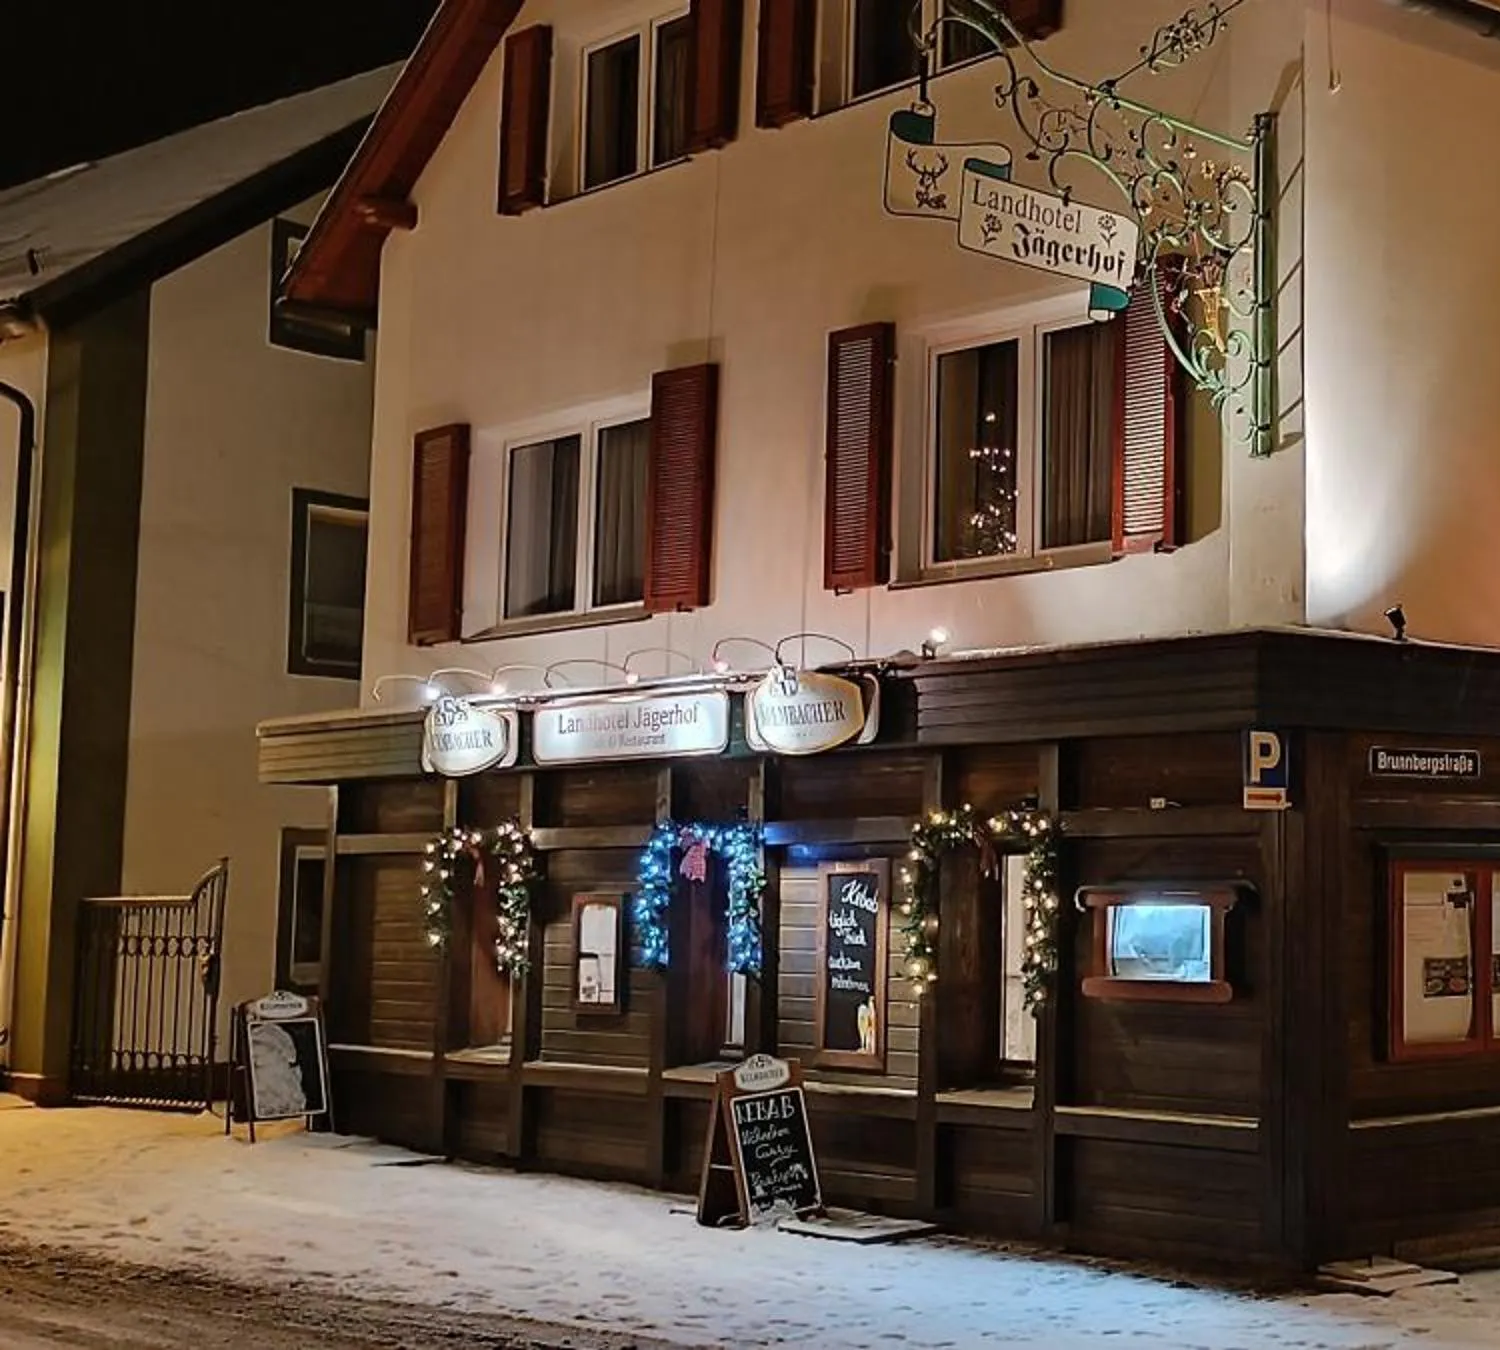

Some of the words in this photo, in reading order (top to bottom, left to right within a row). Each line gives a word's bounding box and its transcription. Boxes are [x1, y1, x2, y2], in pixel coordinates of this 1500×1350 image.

[972, 179, 1081, 234] Landhotel
[1011, 222, 1127, 281] Jägerhof
[633, 701, 701, 732] Jägerhof
[1250, 731, 1281, 783] P
[1377, 751, 1473, 774] Brunnbergstraße
[736, 1095, 796, 1125] KEBAB
